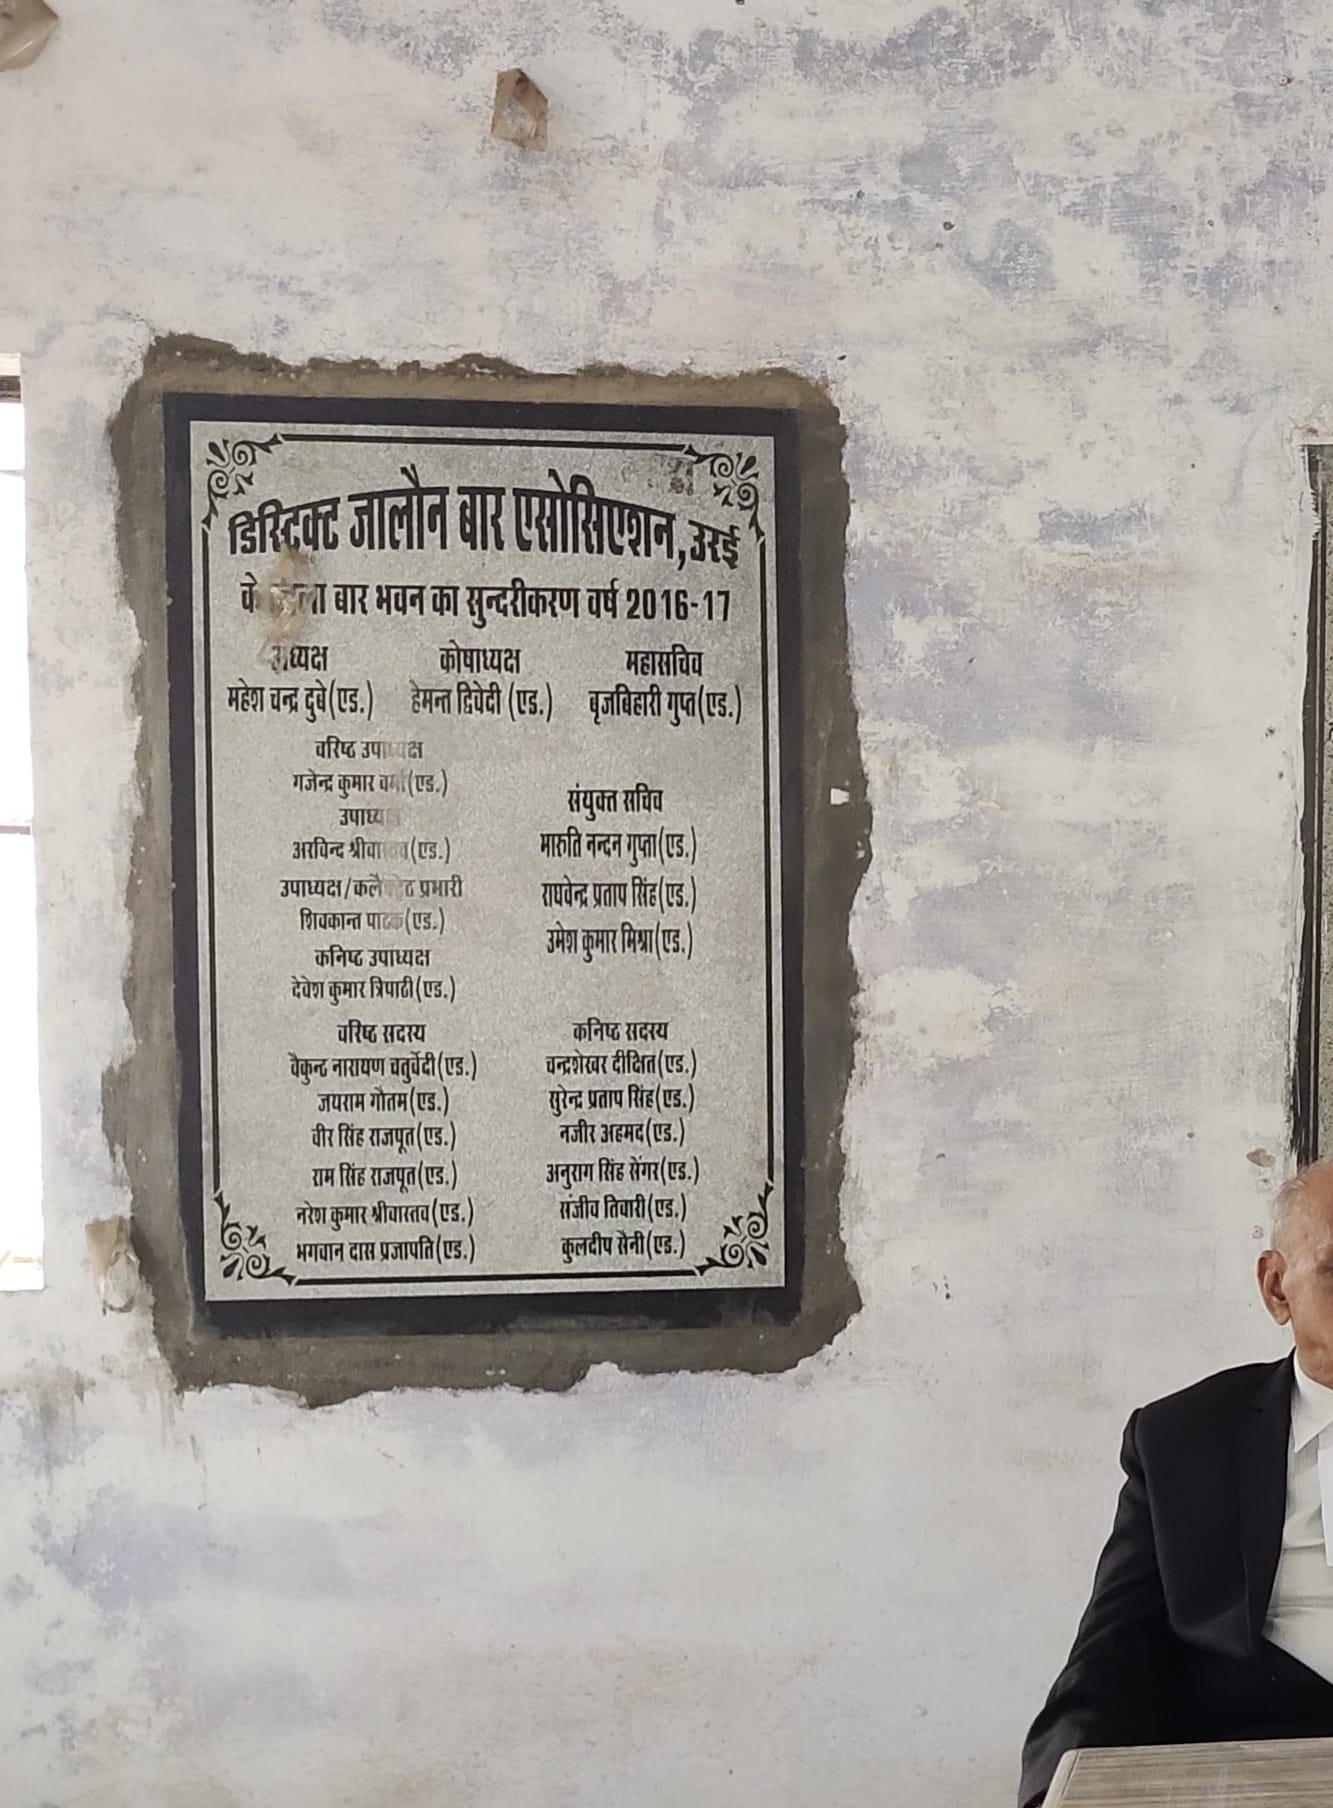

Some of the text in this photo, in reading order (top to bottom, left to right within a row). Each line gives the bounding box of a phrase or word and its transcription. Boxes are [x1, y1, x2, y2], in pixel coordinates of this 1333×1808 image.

[348, 464, 448, 552] जालौन
[457, 485, 505, 551] बार
[333, 578, 732, 628] बार भवन का सुन्दरीकरण वर्ष 2016-17
[439, 639, 521, 674] कोषाध्यक्ष
[625, 644, 703, 677] महासचिव
[227, 678, 298, 713] महेश चन्द्र
[410, 680, 451, 715] हेमन्त
[293, 768, 375, 799] गजेन्द्र कुमार
[567, 782, 663, 821] संयुक्त सचिव
[593, 883, 628, 908] प्रताप
[369, 950, 431, 968] उपाध्यक्ष
[382, 1024, 426, 1044] सदस्य
[625, 1022, 669, 1041] सदस्य
[318, 1093, 365, 1112] जयराम
[297, 1242, 375, 1262] भगवान दास
